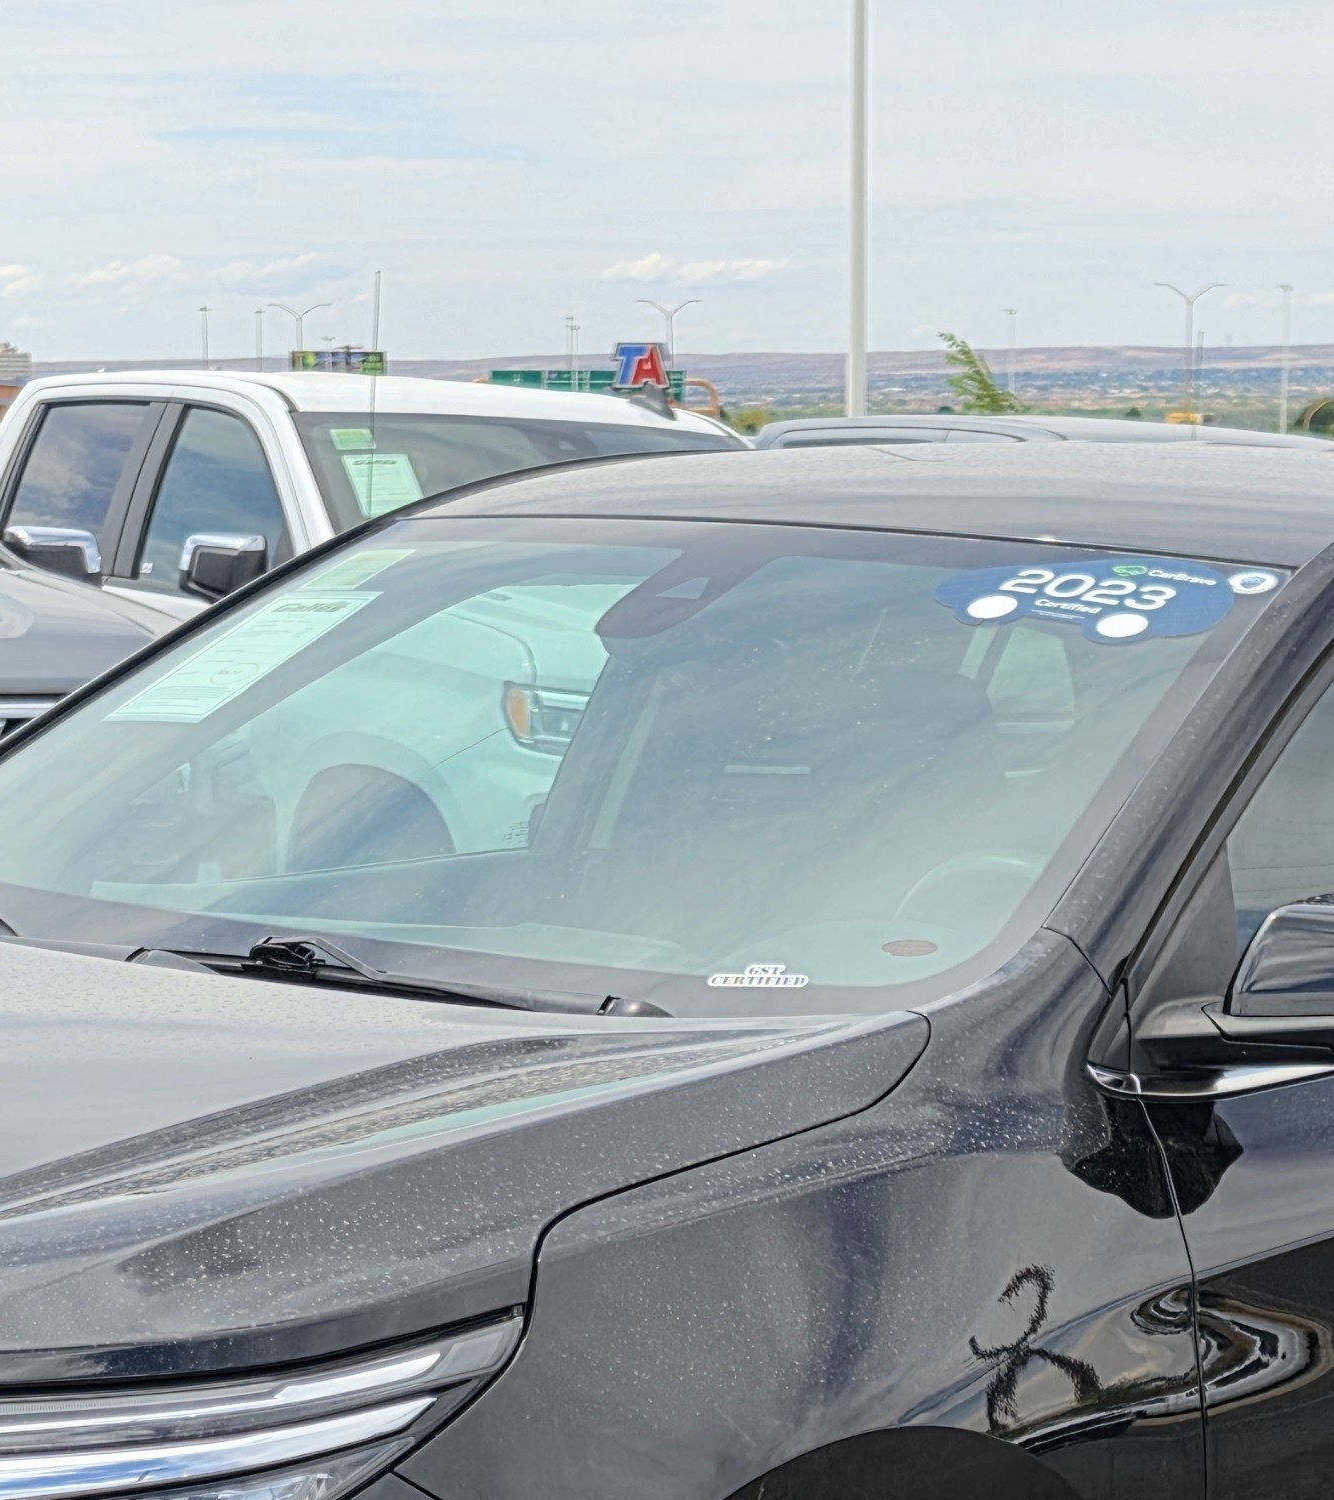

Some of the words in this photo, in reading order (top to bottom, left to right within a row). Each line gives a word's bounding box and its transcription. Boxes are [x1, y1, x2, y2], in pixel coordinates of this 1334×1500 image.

[615, 342, 670, 389] TA
[999, 569, 1178, 611] 2023
[1035, 597, 1102, 615] Certified
[711, 976, 806, 986] CERTIFIED
